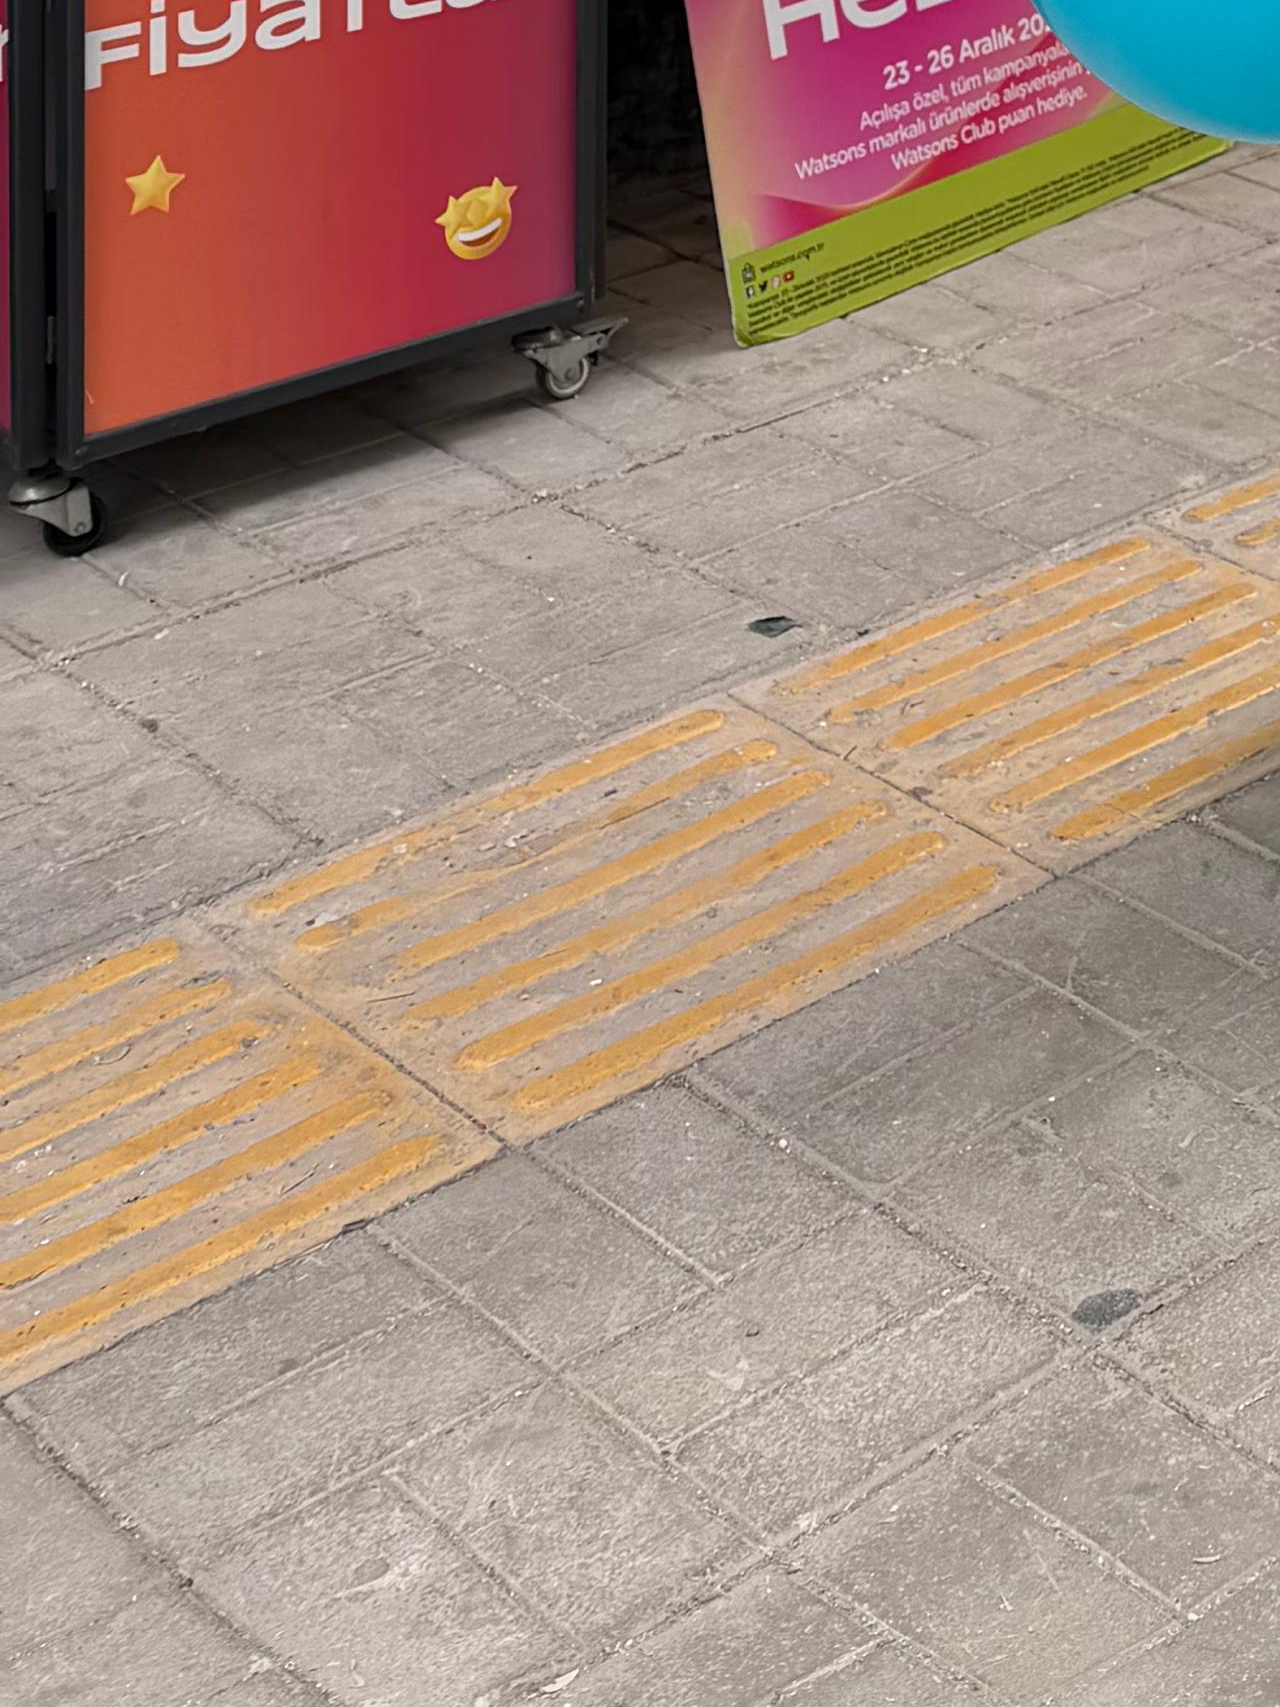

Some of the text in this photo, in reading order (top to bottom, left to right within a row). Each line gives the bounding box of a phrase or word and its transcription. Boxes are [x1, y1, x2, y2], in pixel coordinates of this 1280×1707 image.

[883, 60, 911, 90] 23
[928, 45, 955, 75] 26
[959, 24, 1016, 64] Aralık
[1017, 12, 1050, 42] 20
[794, 60, 1083, 180] Watsons markalı ürünlerde alışverişinin
[860, 103, 910, 131] Açılışa
[913, 87, 949, 110] özel,
[951, 75, 982, 97] tüm
[890, 83, 1088, 171] Watsons Club puan hediye.
